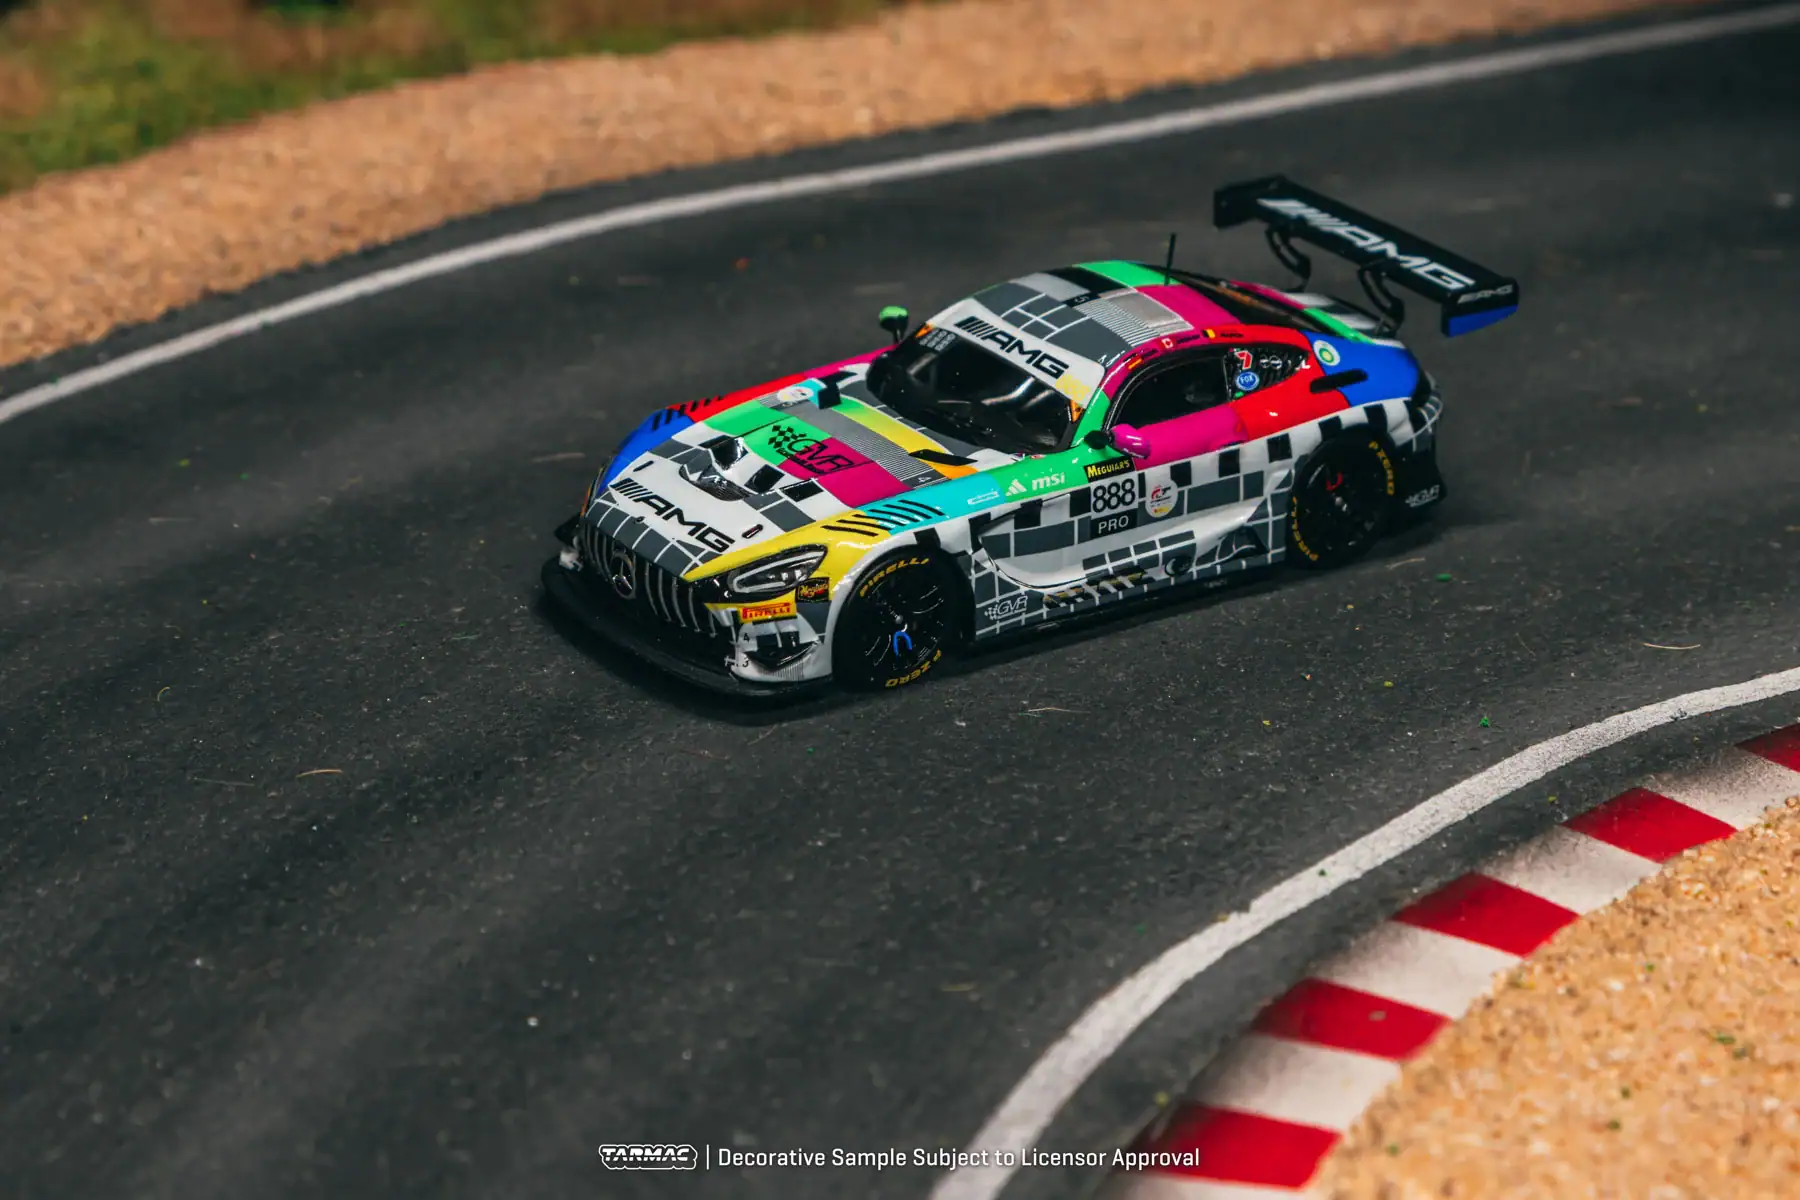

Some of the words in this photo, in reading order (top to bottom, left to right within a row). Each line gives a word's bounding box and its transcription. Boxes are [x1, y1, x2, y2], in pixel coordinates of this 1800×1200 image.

[979, 331, 1070, 379] AMG
[1031, 472, 1066, 491] msi
[1092, 478, 1135, 513] 888
[631, 494, 736, 553] AMG
[1098, 515, 1130, 534] PRO
[859, 556, 930, 597] PIRELLI
[742, 602, 791, 619] PIRELLI
